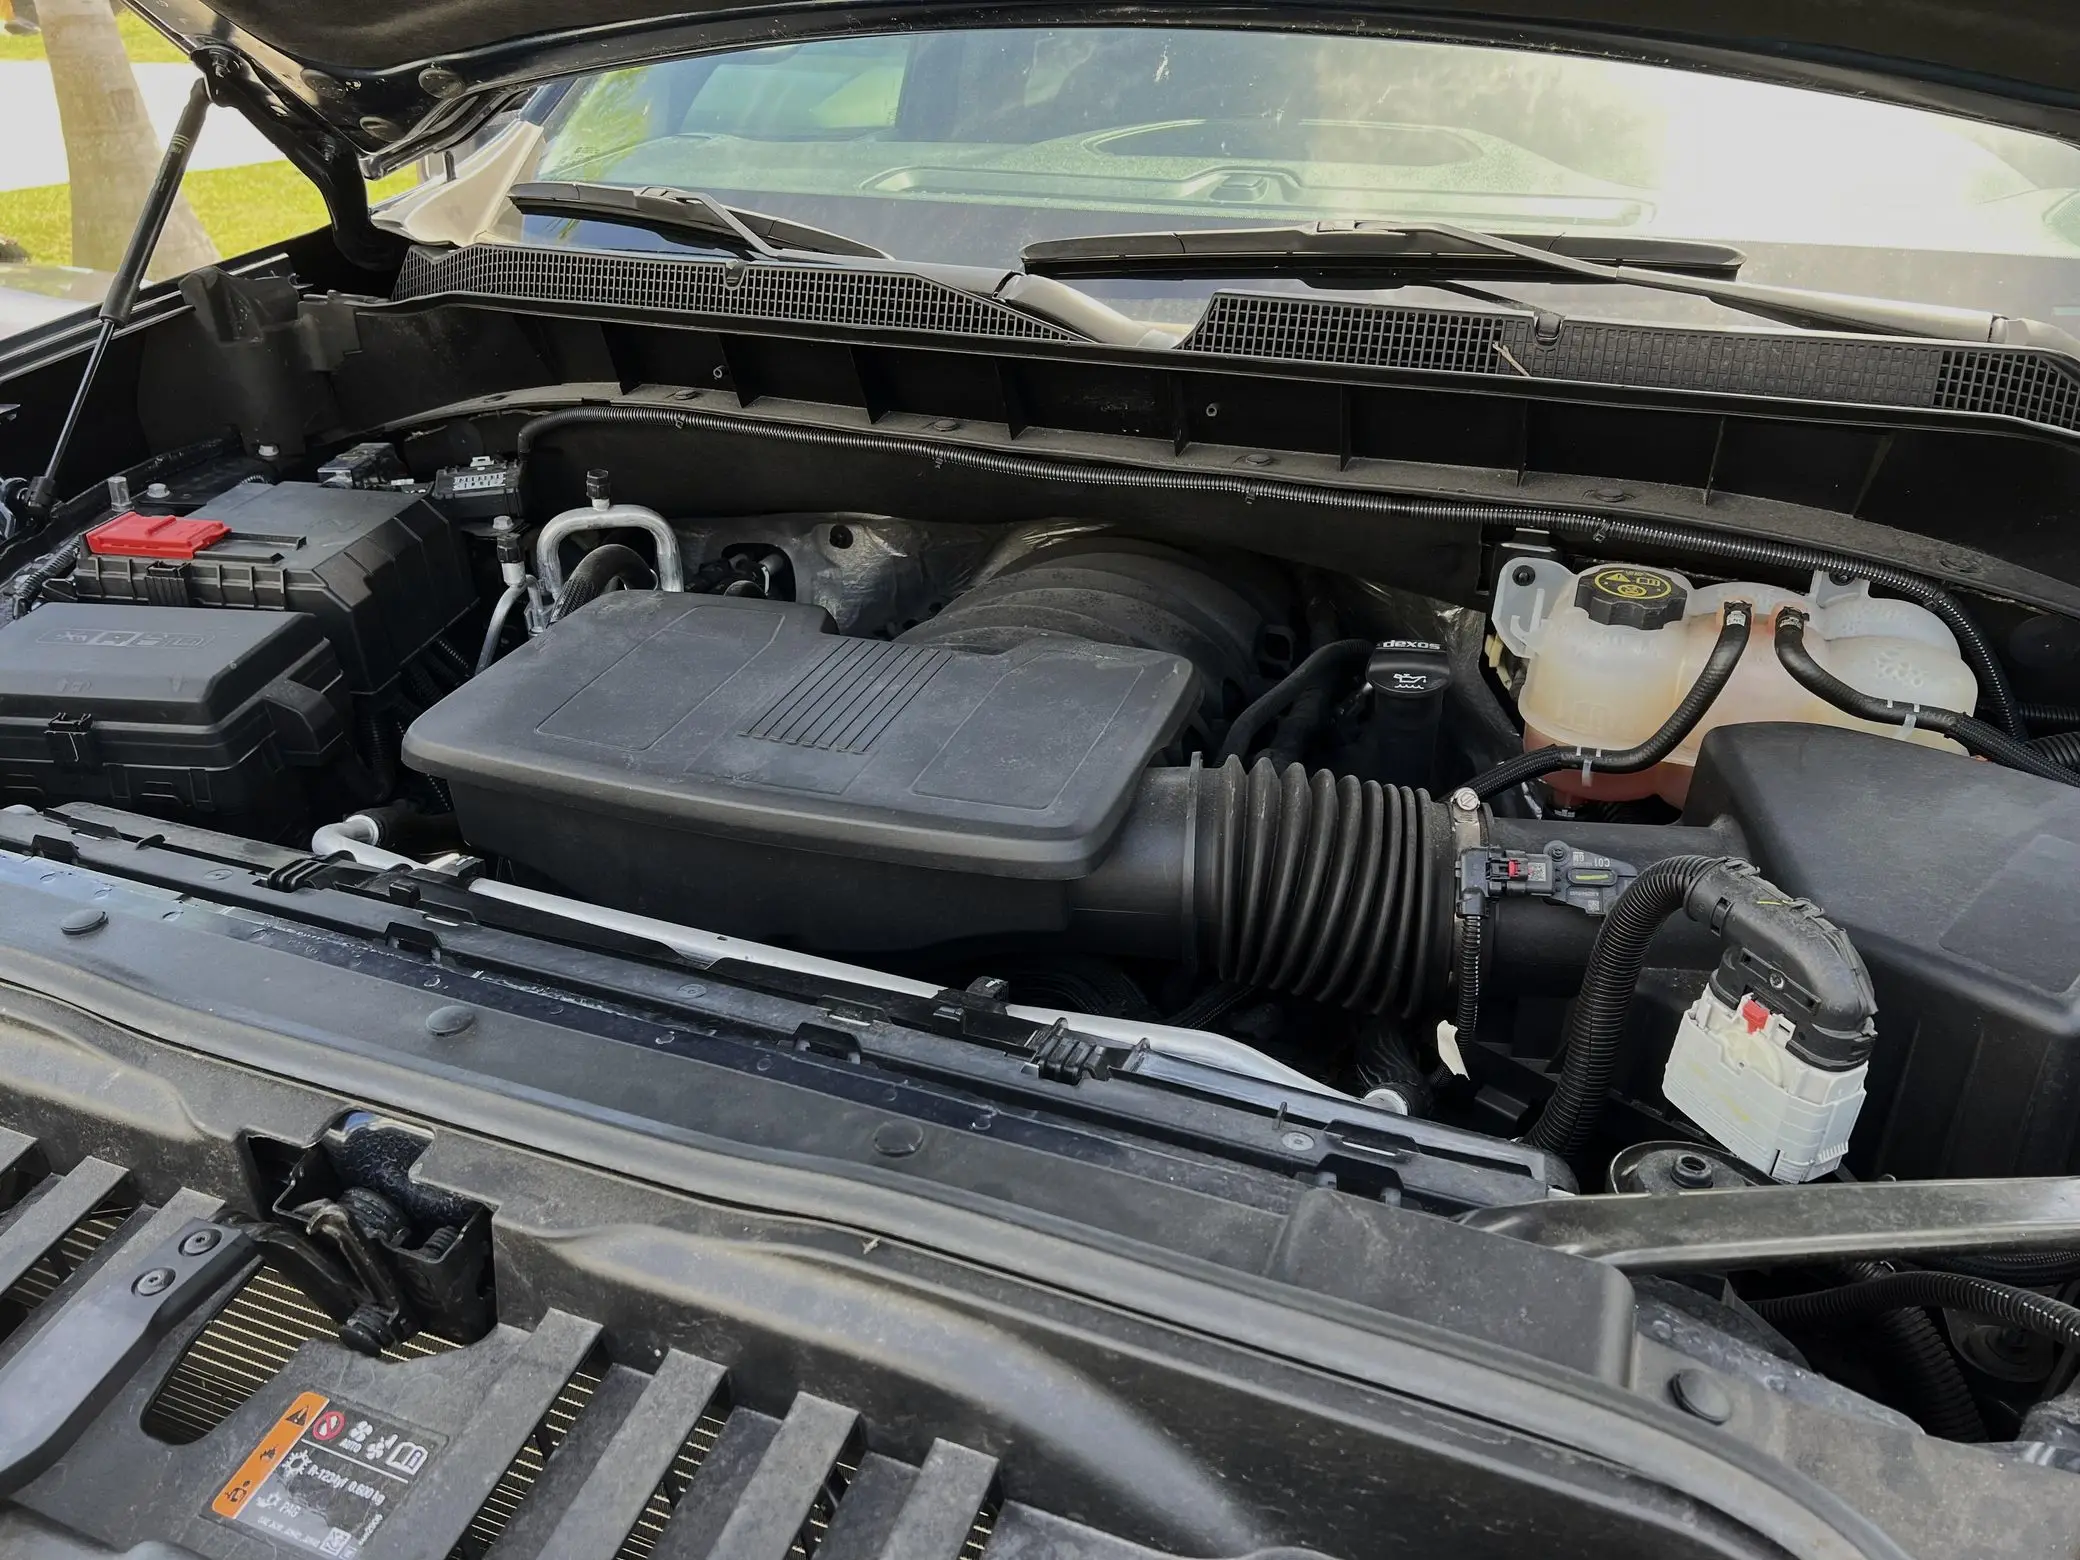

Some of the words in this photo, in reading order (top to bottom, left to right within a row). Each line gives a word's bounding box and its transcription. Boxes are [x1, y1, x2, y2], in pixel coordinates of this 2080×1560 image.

[1382, 640, 1441, 650] dexos
[338, 1438, 362, 1453] AUTO
[279, 1501, 301, 1518] PAG
